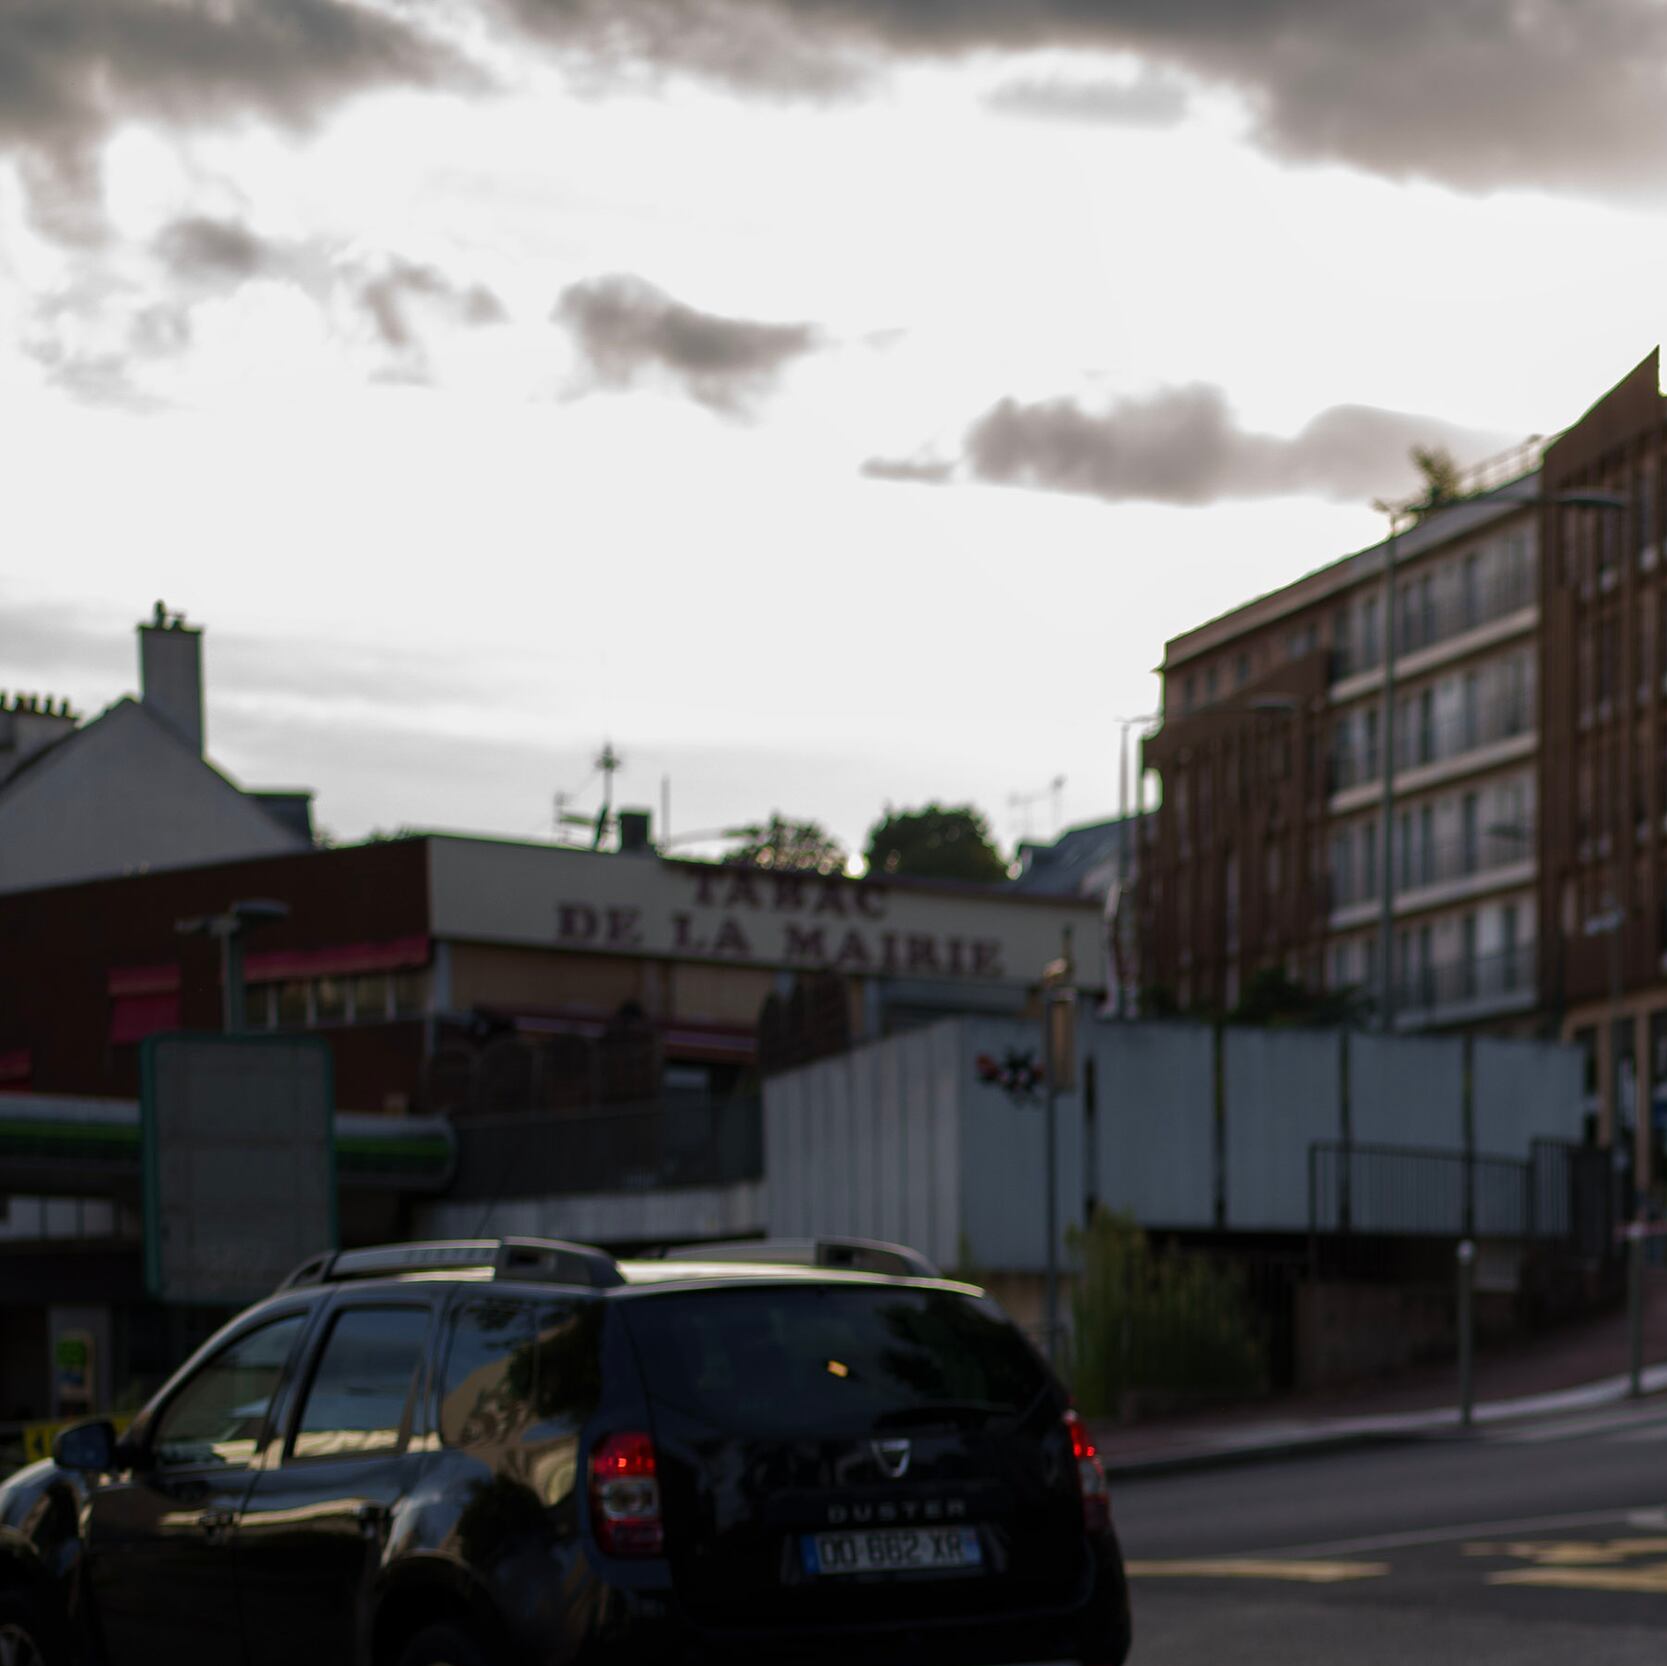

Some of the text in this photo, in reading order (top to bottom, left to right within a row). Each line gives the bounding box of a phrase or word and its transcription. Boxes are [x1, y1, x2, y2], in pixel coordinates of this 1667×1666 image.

[695, 864, 887, 919] TABAC
[559, 905, 1003, 979] DE LA MAIRIE
[827, 1498, 967, 1525] DUSTER
